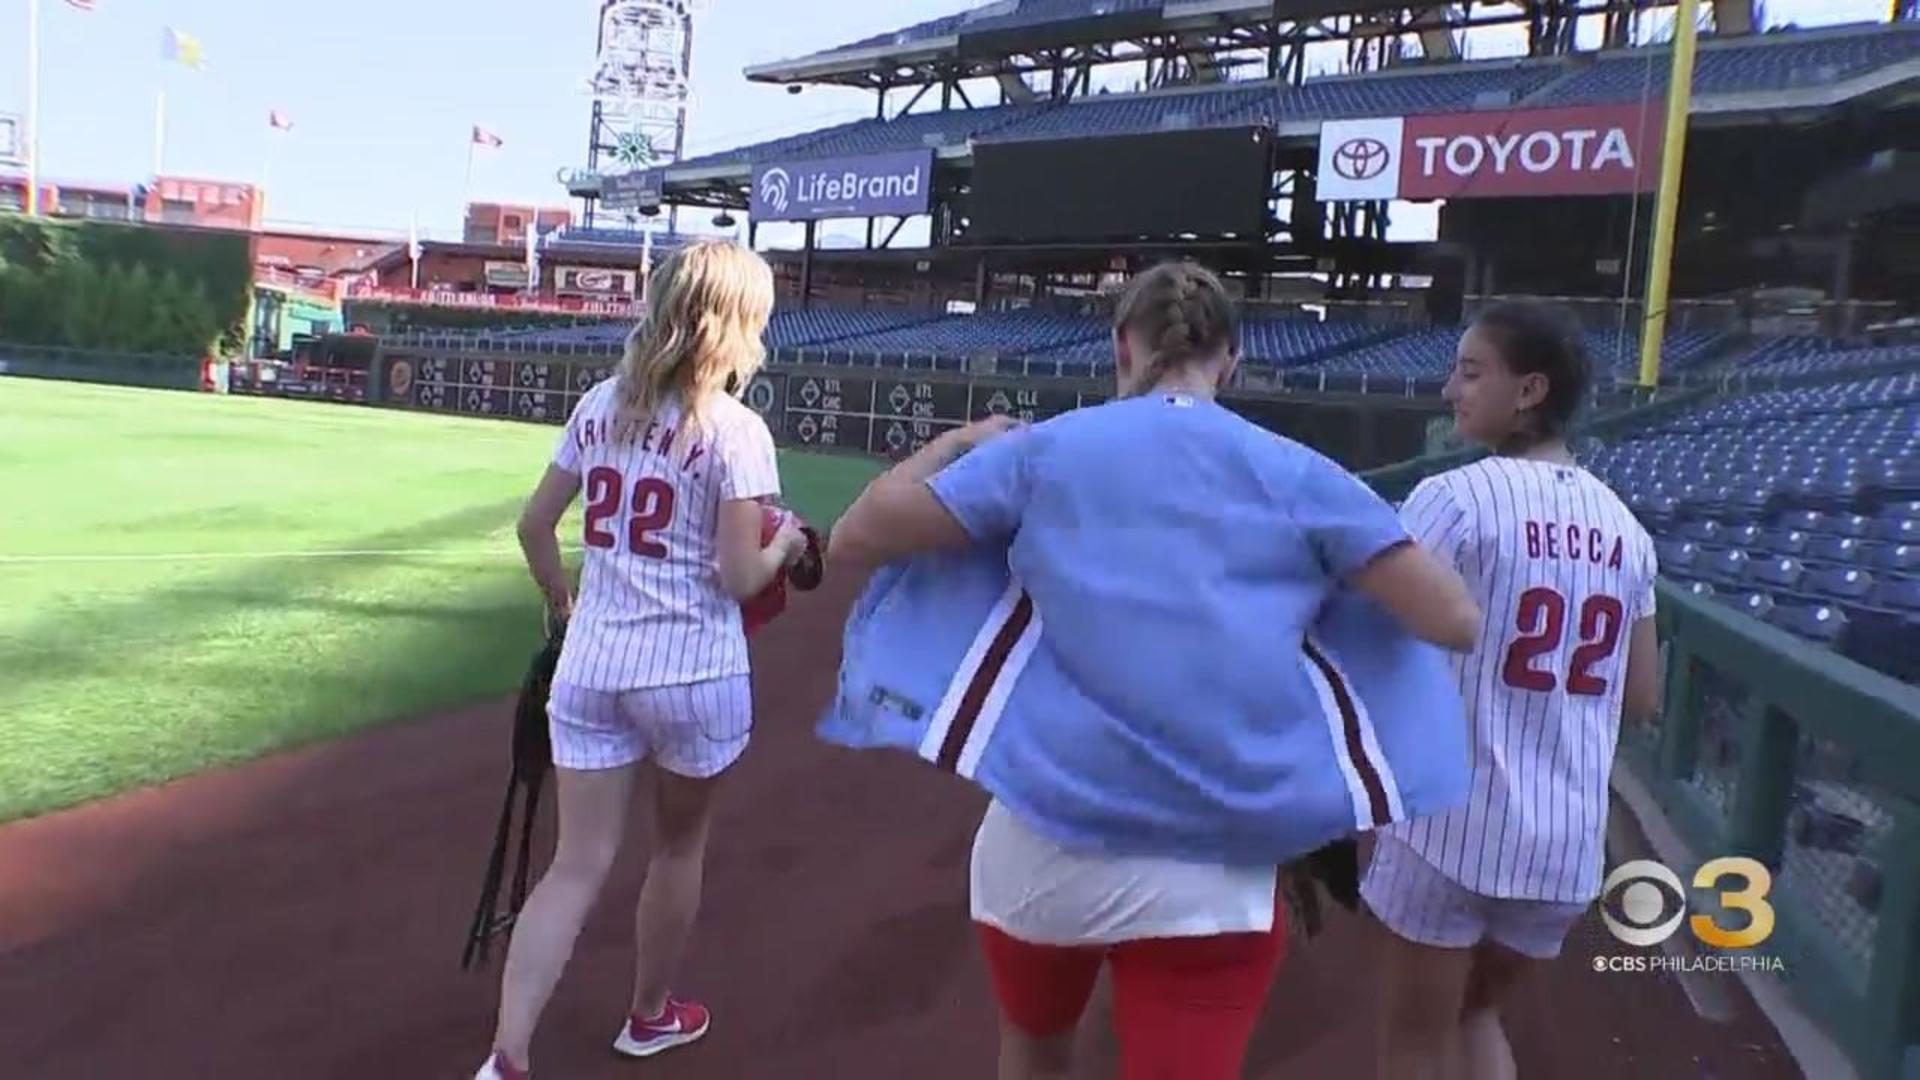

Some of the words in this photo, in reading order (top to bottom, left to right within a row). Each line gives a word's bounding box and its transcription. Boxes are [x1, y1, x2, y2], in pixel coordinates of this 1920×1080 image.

[1415, 127, 1635, 177] TOYOTA
[797, 165, 919, 202] LifeBrand
[584, 466, 675, 560] 22
[1525, 520, 1623, 571] BECCA
[1502, 586, 1624, 697] 22
